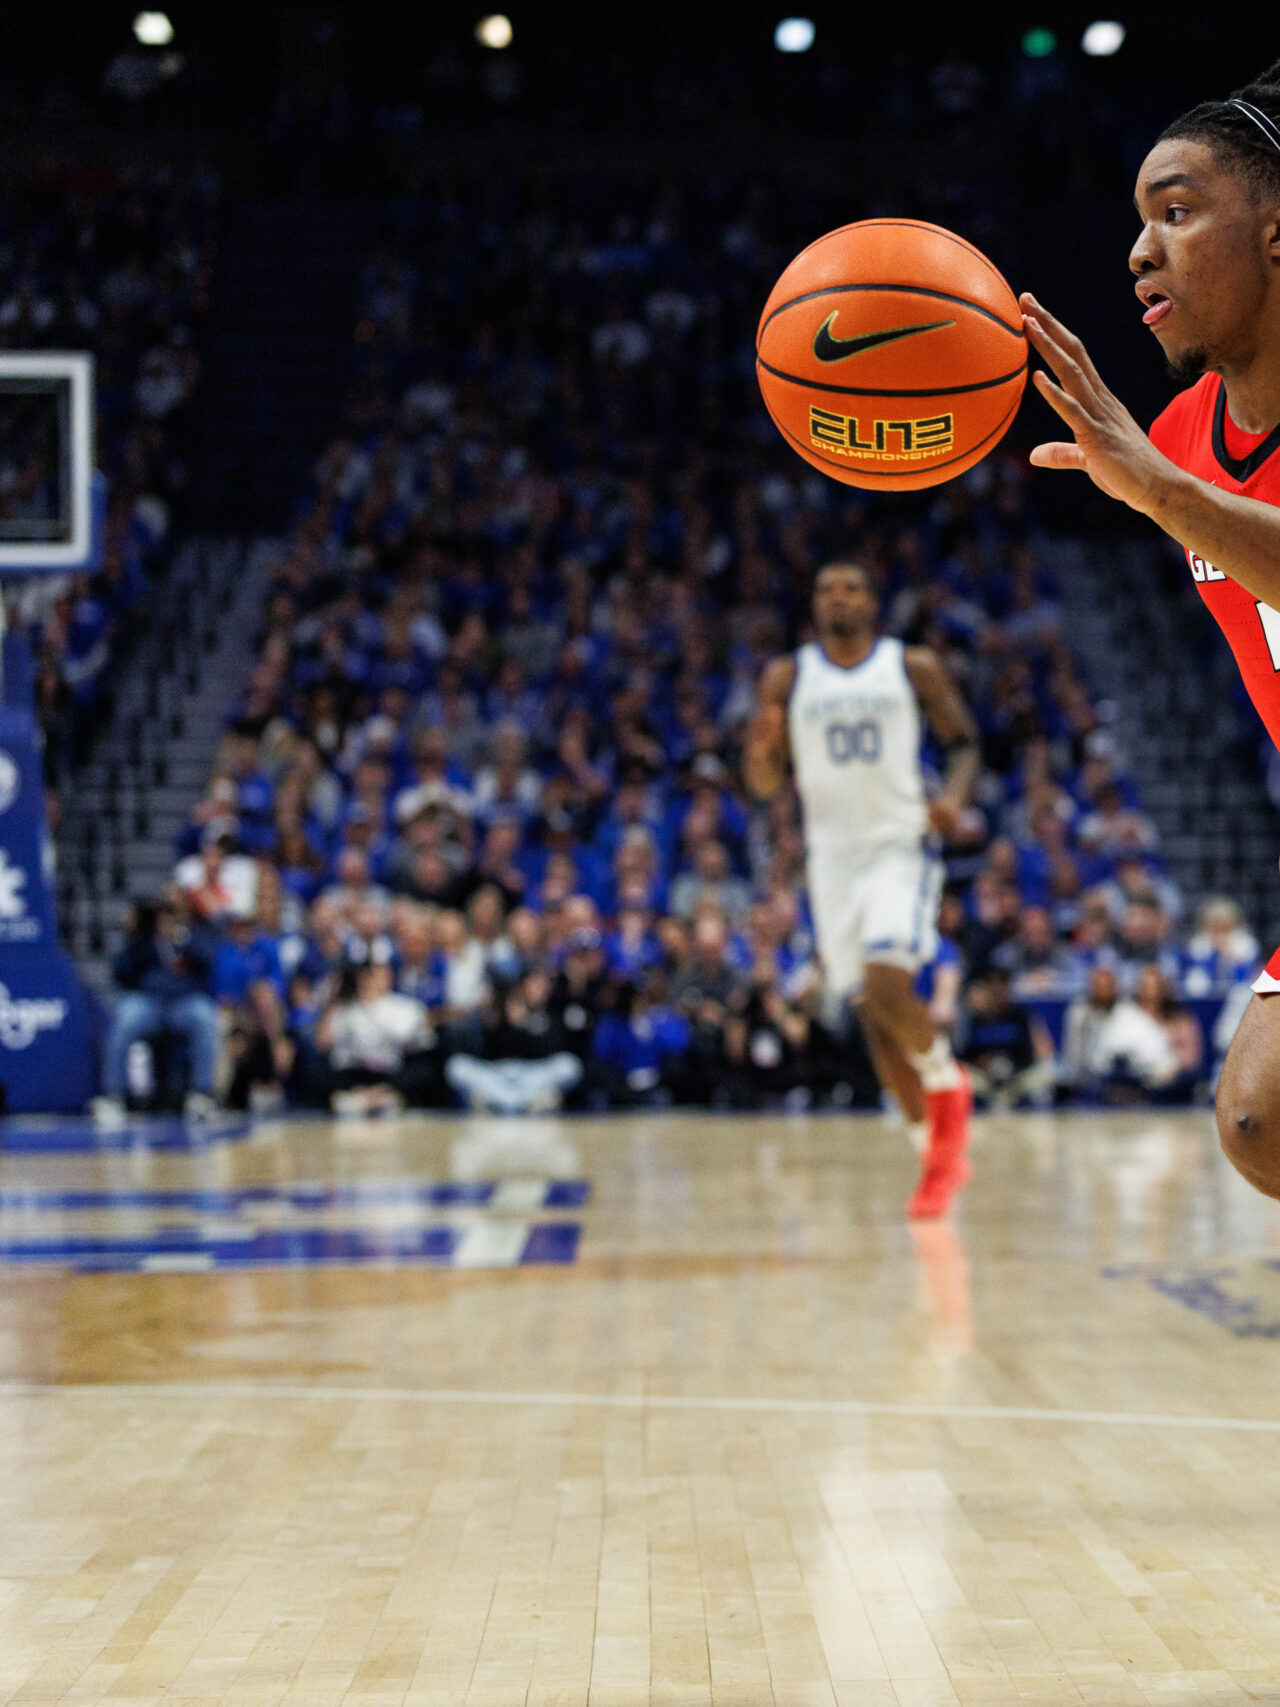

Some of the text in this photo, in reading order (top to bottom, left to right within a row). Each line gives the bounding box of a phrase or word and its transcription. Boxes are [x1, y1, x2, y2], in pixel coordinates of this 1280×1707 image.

[809, 404, 953, 453] ELITE
[811, 438, 953, 461] CHAMPIONSHIP
[825, 719, 883, 765] 00
